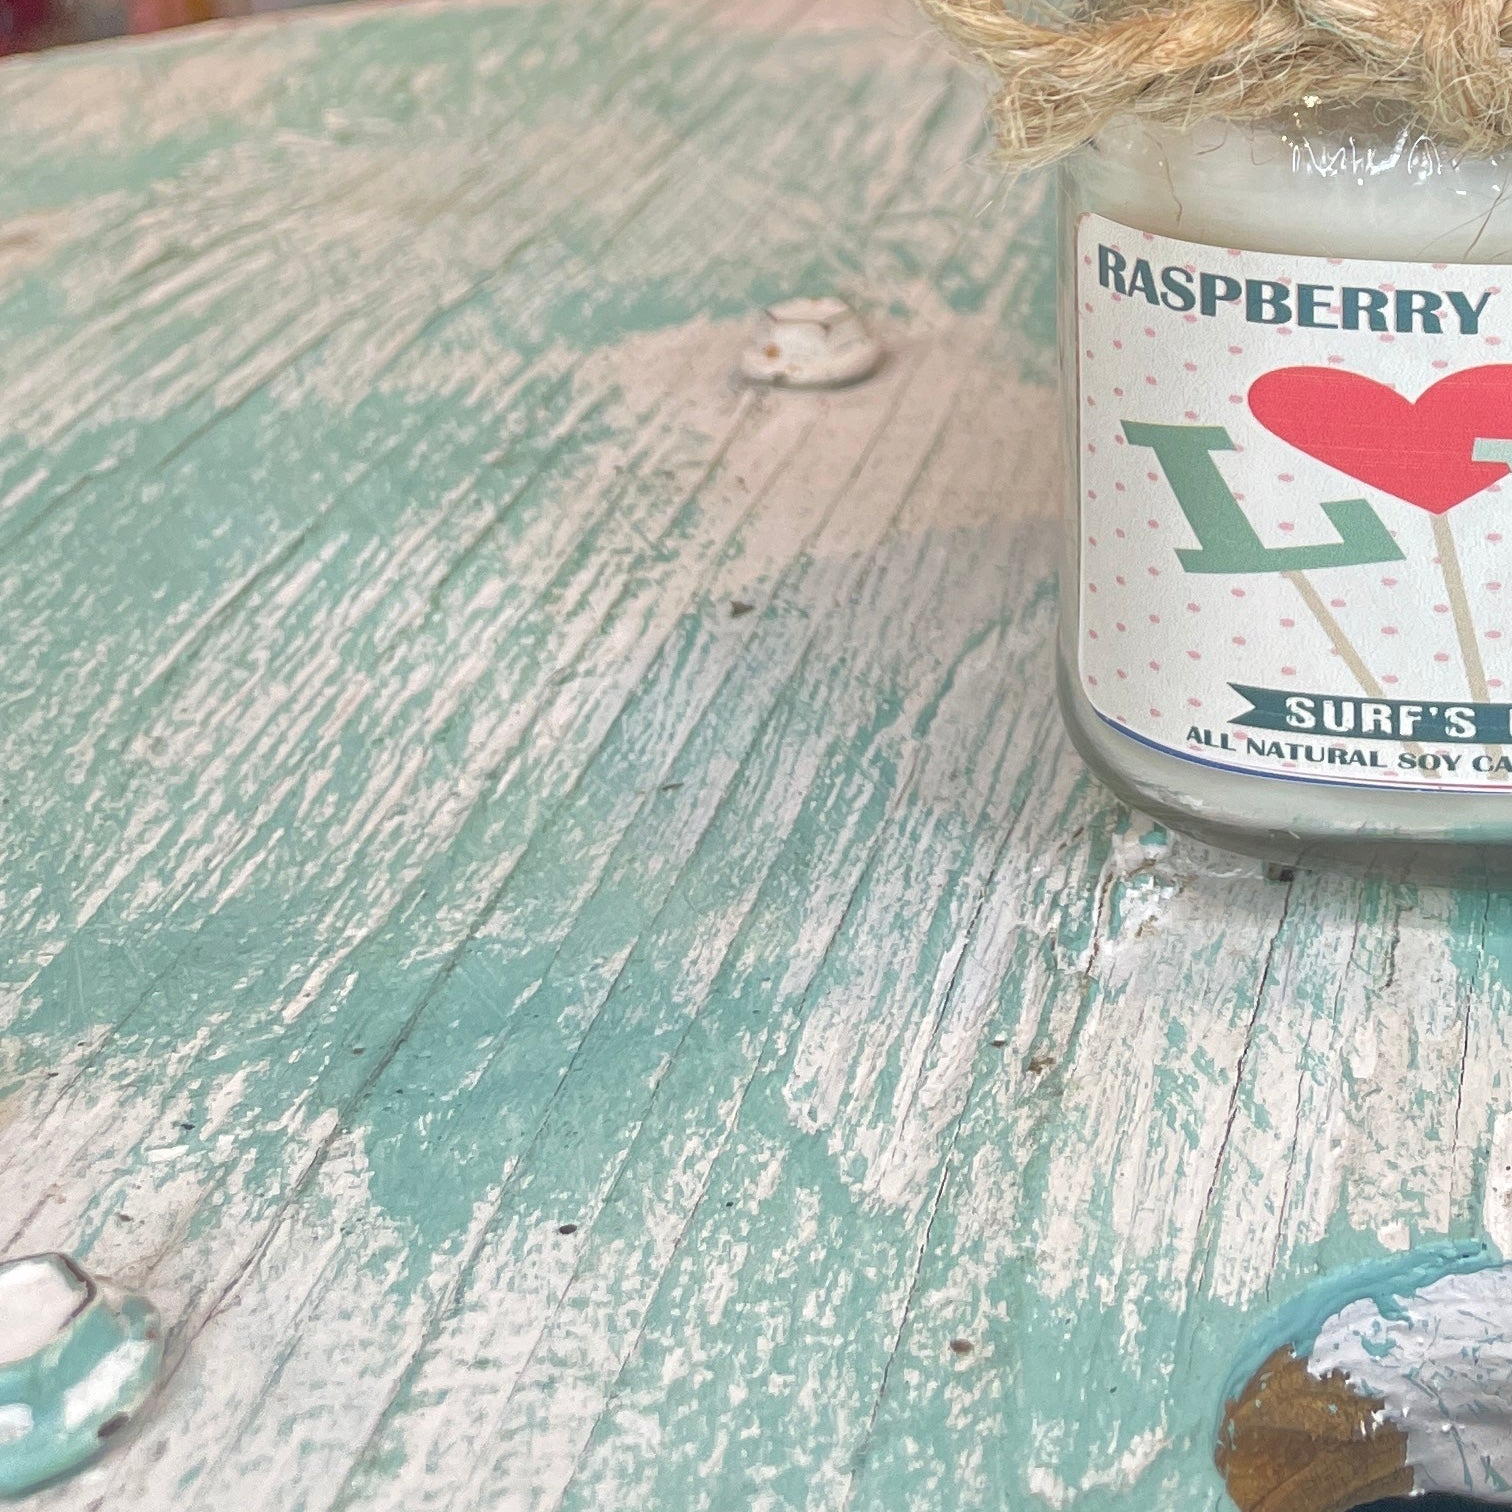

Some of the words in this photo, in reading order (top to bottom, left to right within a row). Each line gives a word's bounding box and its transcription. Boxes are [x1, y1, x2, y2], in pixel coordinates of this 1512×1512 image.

[1098, 243, 1492, 335] RASPBERRY
[1284, 696, 1477, 738] SURF'S
[1186, 725, 1237, 752] ALL
[1246, 737, 1388, 769] NATURAL
[1397, 753, 1462, 772] SOY
